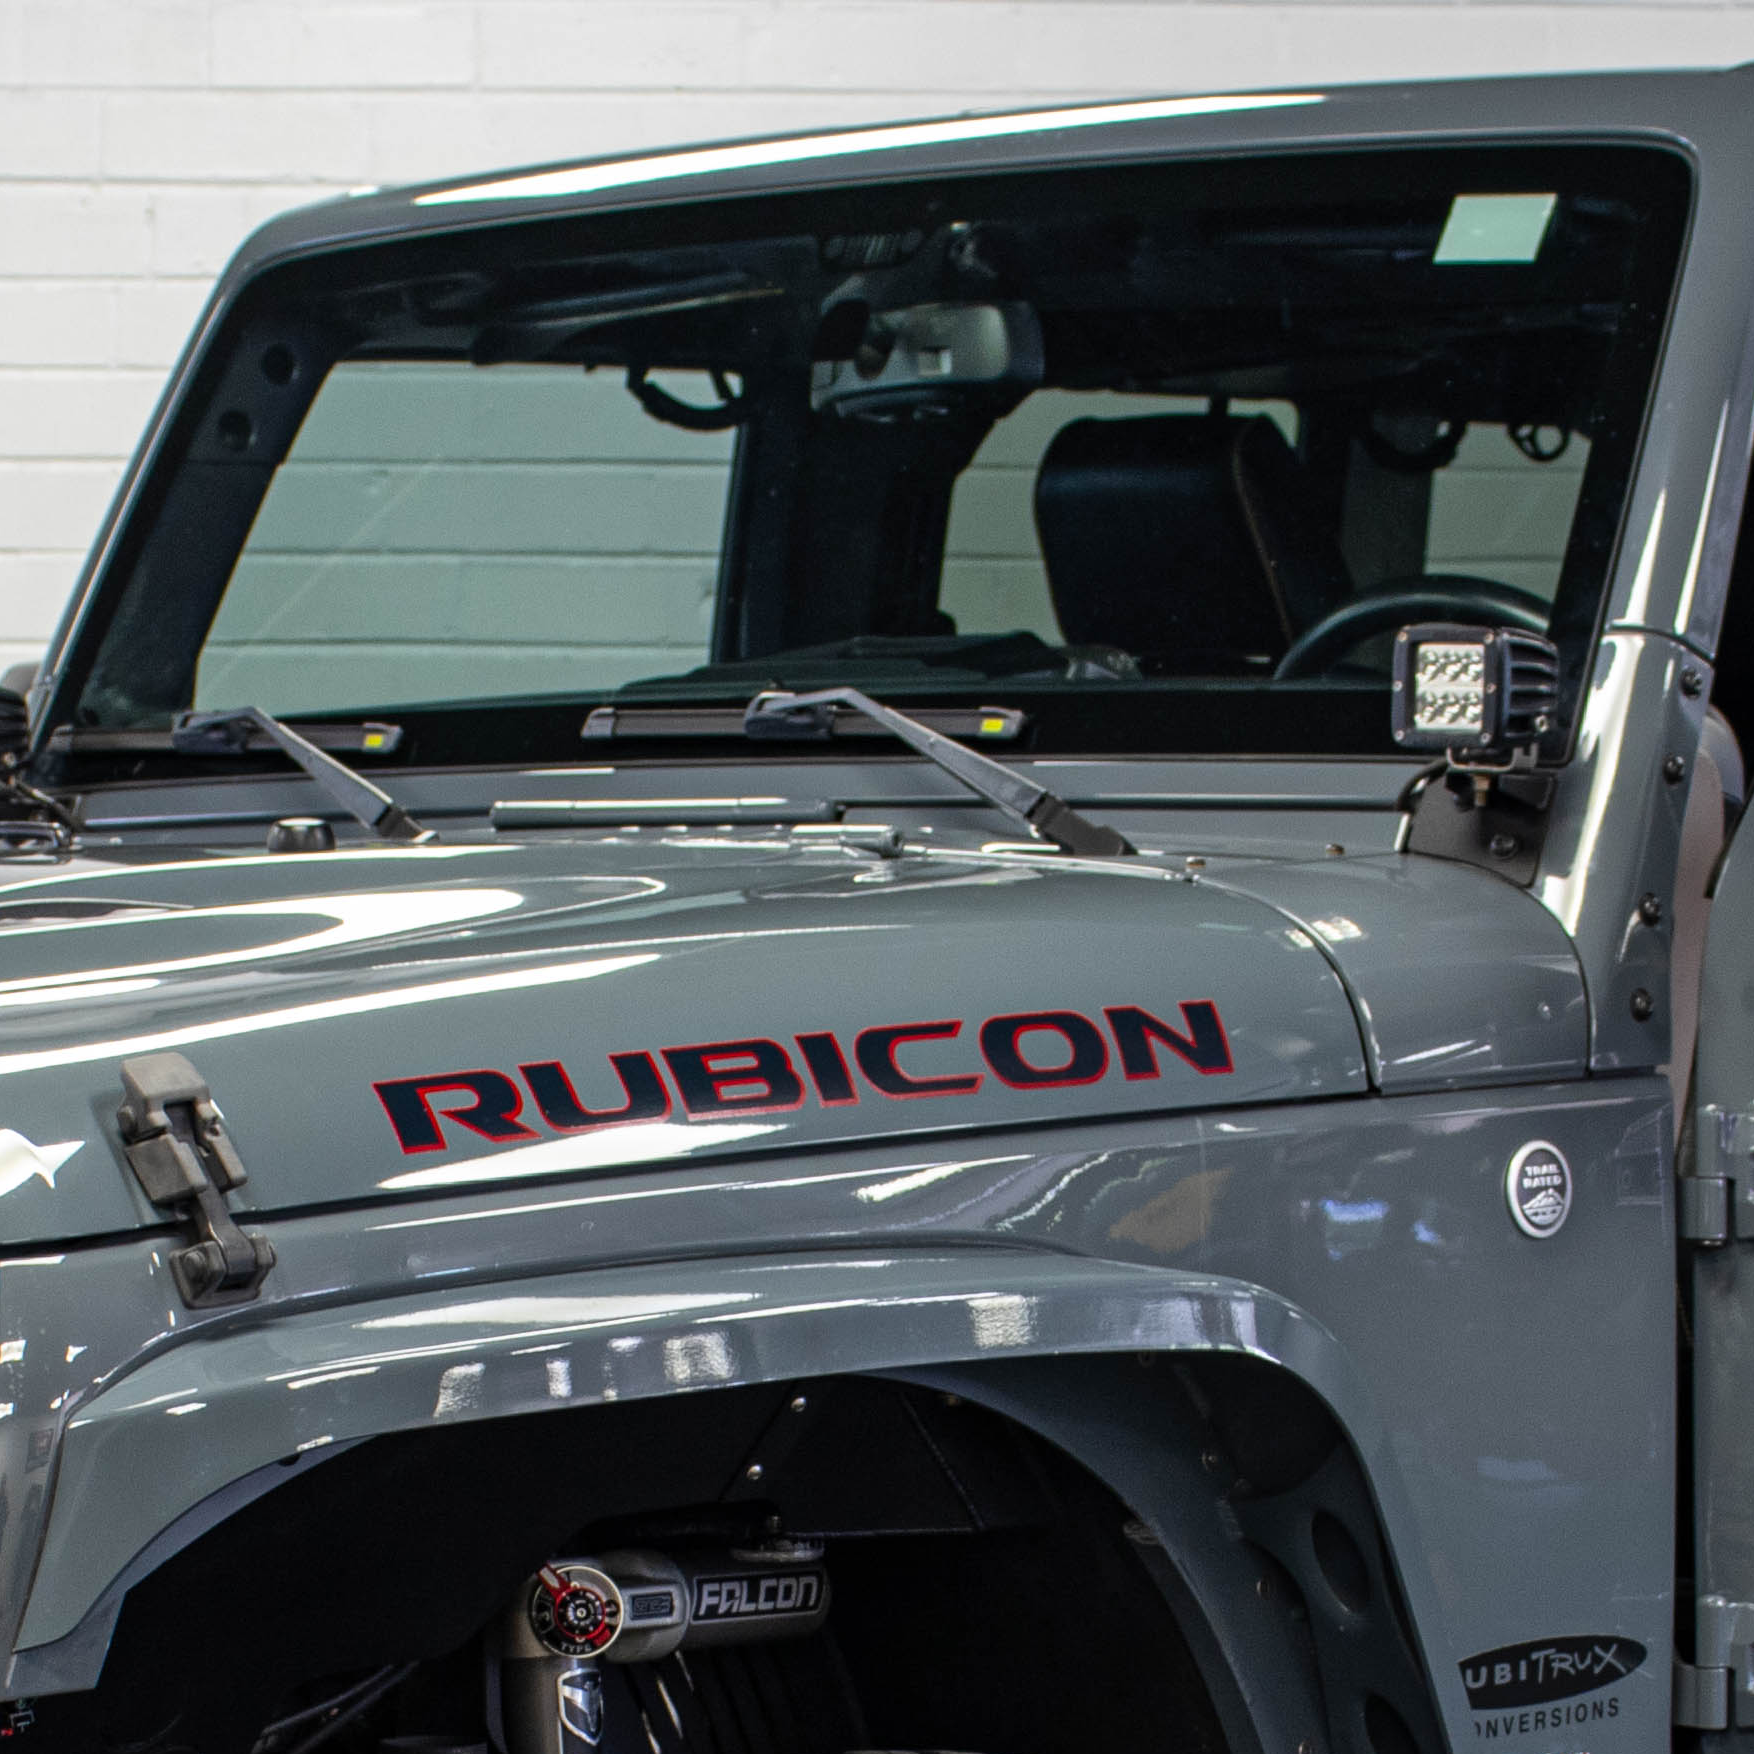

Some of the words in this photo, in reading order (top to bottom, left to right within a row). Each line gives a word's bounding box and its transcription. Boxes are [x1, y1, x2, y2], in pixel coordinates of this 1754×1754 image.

[372, 999, 1235, 1156] RUBICON
[1522, 1175, 1562, 1189] RATED
[1524, 1164, 1559, 1176] TRAIL
[698, 1576, 818, 1616] FALCON
